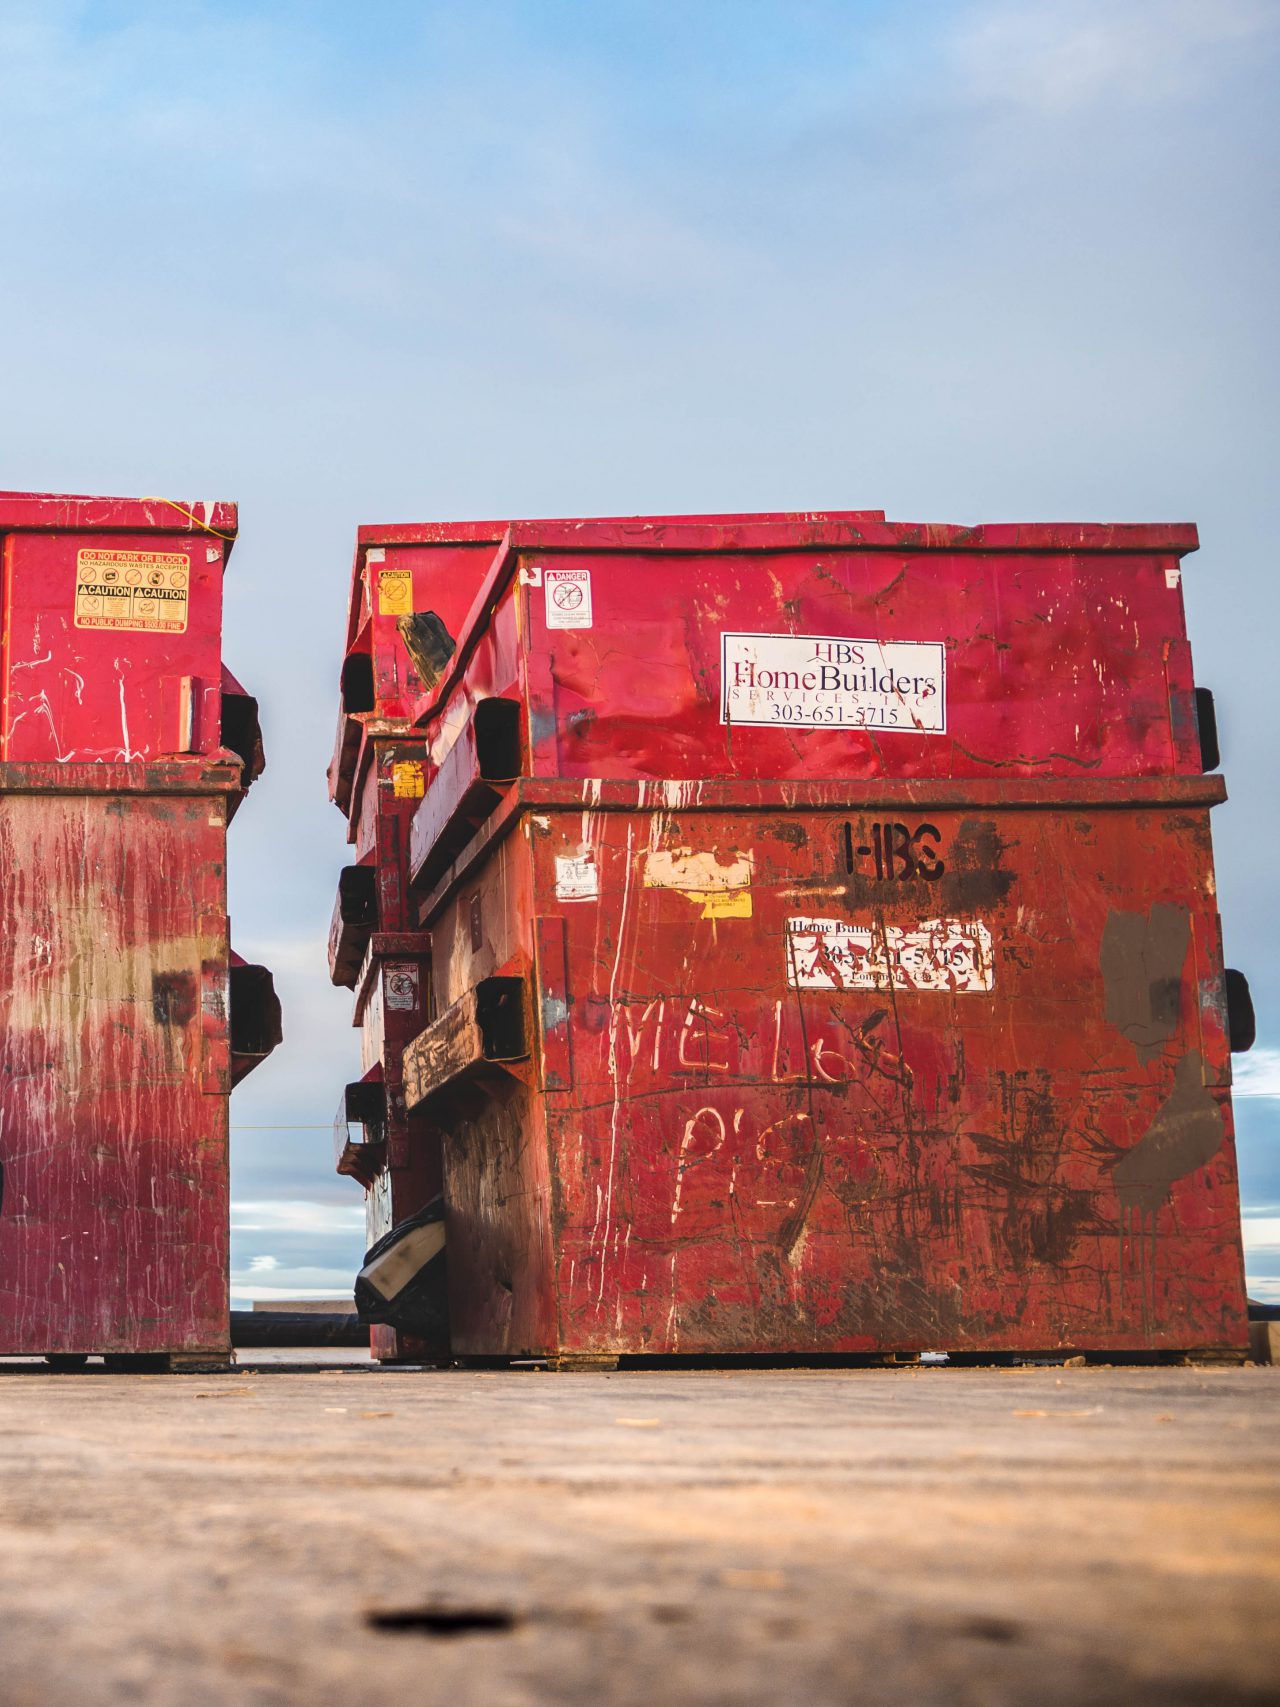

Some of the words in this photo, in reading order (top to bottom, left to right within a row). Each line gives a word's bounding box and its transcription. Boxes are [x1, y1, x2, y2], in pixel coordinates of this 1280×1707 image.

[83, 552, 96, 560] DO
[98, 552, 115, 560] NOT
[116, 553, 139, 562] PARK
[141, 554, 154, 563] OR
[155, 555, 184, 565] BLOCK
[556, 572, 587, 581] DANGER
[88, 586, 131, 596] CAUTION
[143, 589, 186, 599] CAUTION
[80, 617, 90, 625] NO
[91, 618, 114, 626] PUBLIC
[115, 619, 143, 628] DUMPING
[167, 622, 181, 630] FINE
[815, 643, 865, 665] HBS
[732, 662, 937, 696] HomeBuilders
[771, 703, 899, 725] 303-651-5715
[792, 920, 832, 933] Home
